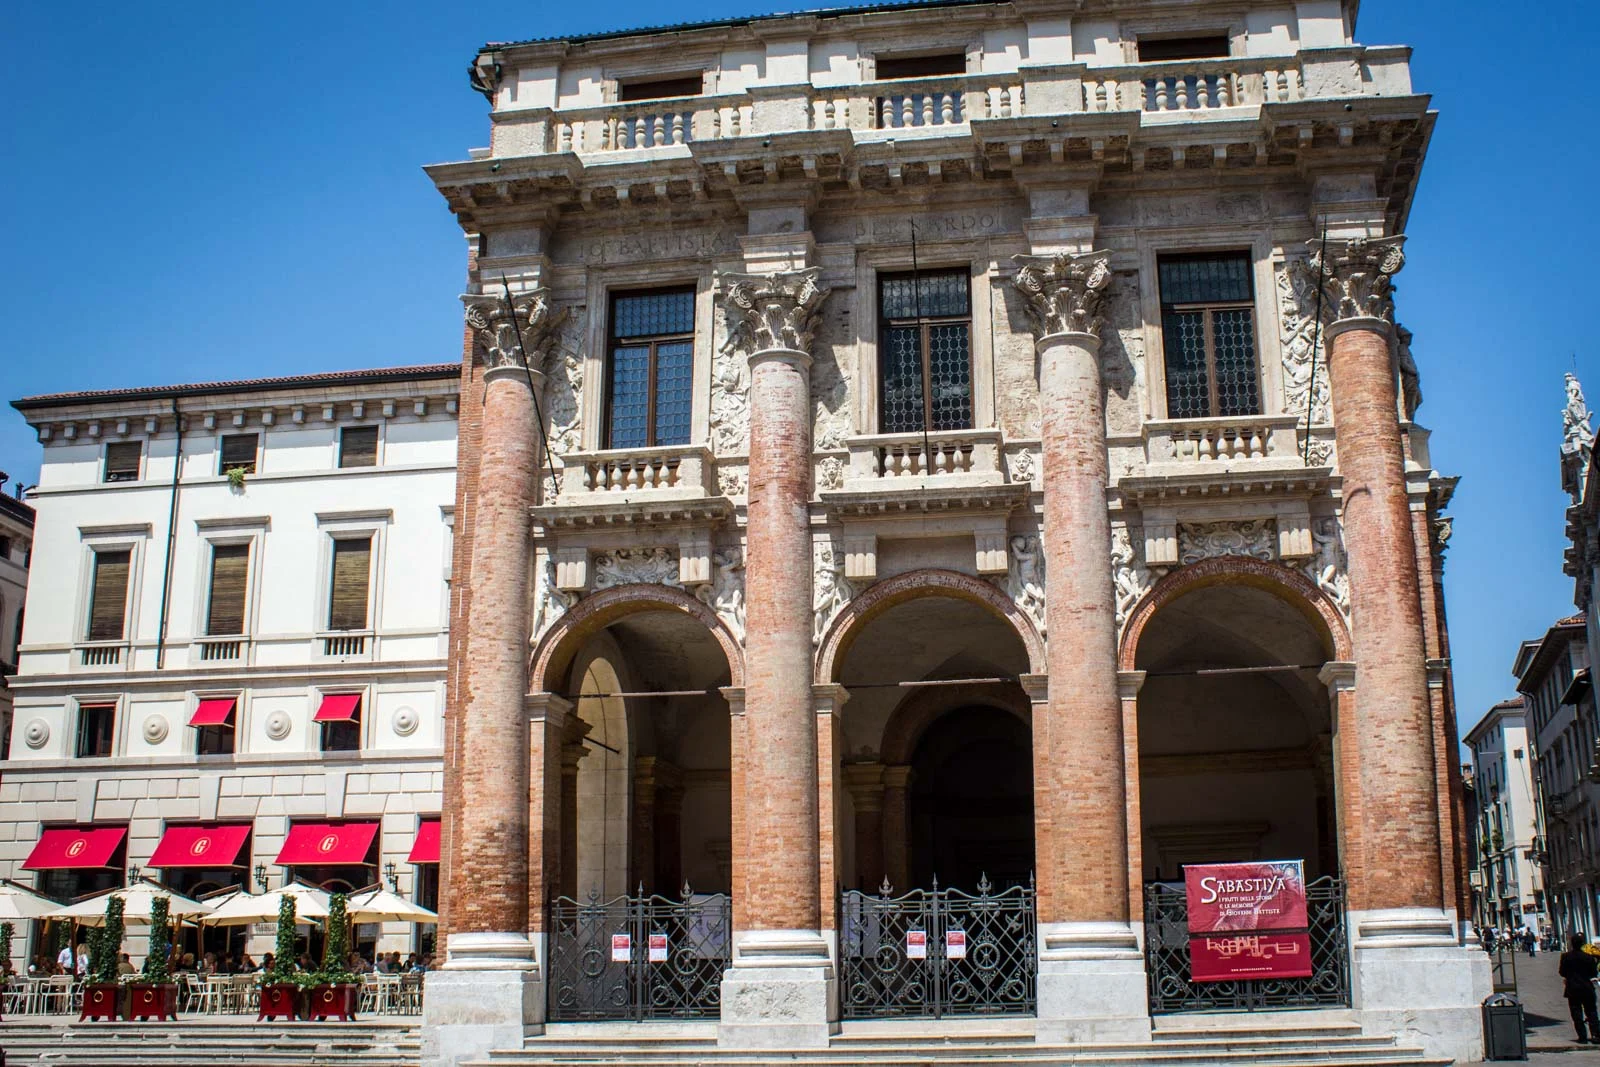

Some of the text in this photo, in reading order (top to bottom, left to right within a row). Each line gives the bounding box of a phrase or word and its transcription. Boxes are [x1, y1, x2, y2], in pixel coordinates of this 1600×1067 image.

[68, 841, 83, 856] G
[194, 839, 208, 854] G
[321, 836, 336, 851] G
[1200, 875, 1286, 904] SABASTIYA
